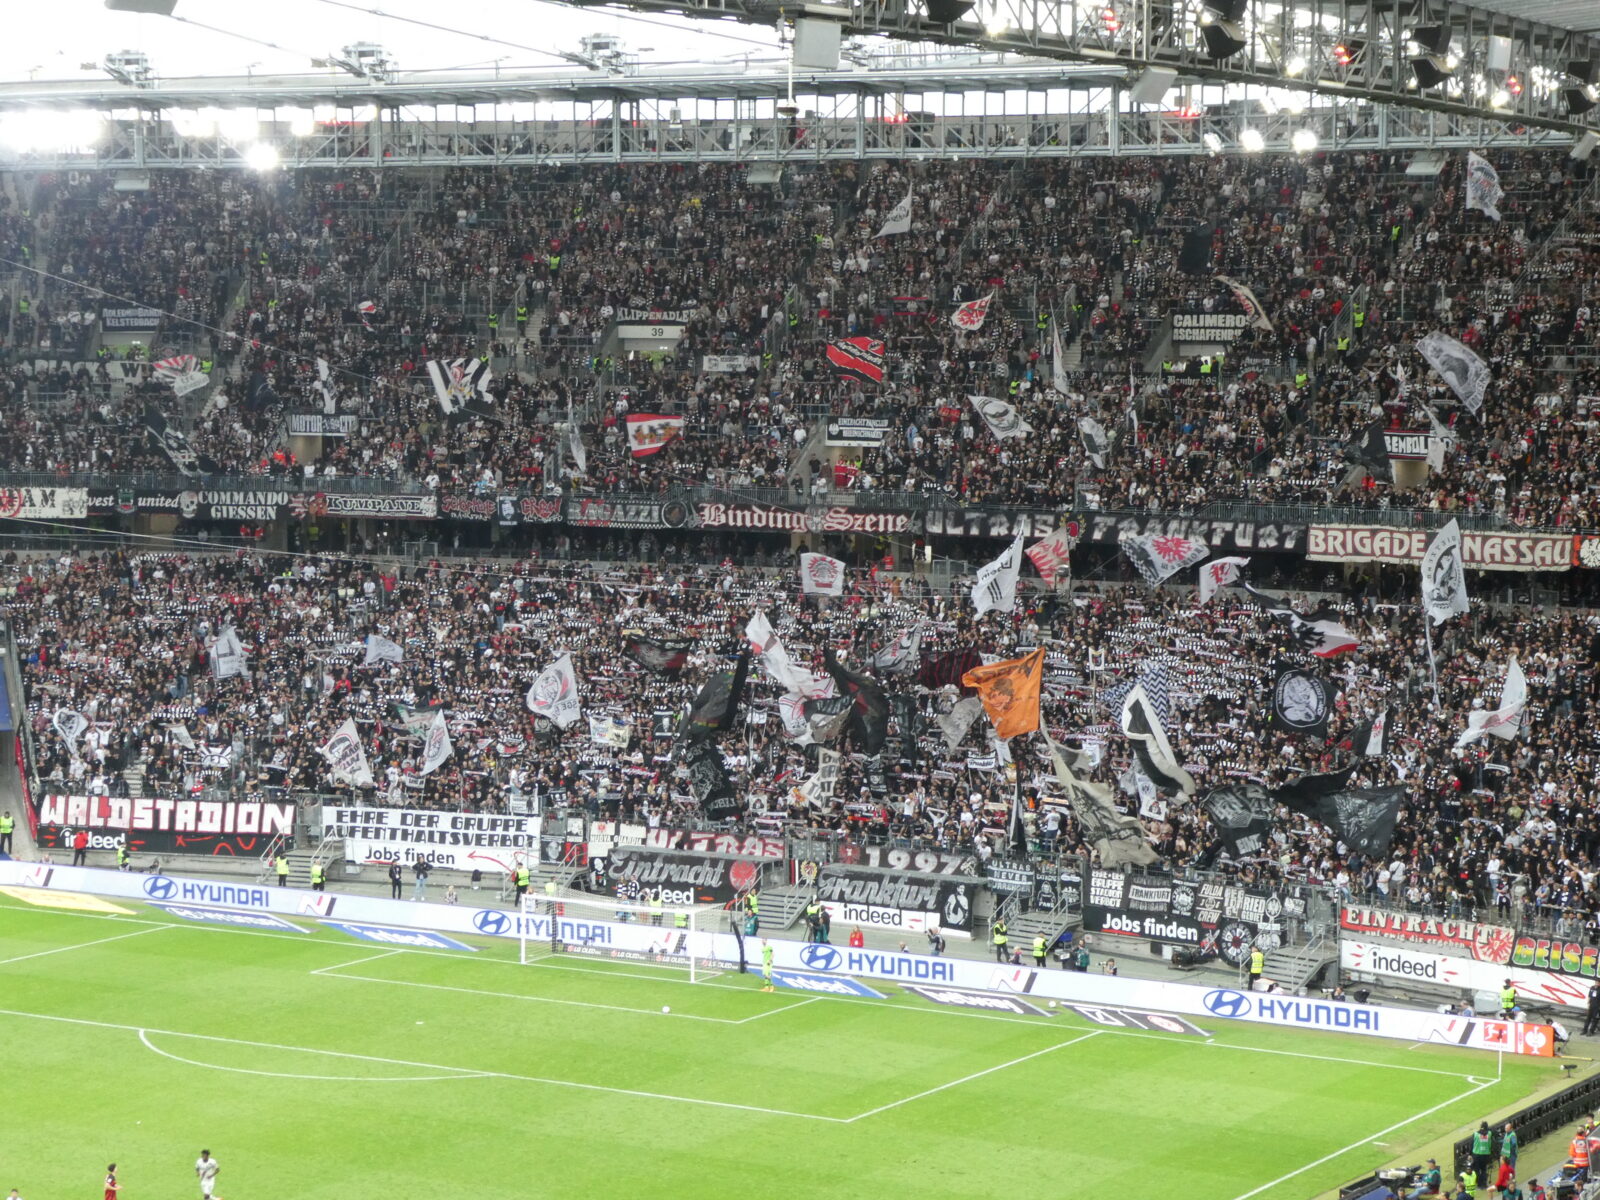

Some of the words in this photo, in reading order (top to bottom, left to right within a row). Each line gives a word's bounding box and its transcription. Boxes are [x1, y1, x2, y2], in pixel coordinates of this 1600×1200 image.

[616, 306, 697, 323] KLIPPENADLER
[651, 328, 664, 337] 39
[1173, 328, 1243, 341] ASCHAFFENBU
[292, 414, 322, 432] MOTOR
[138, 493, 180, 508] united
[198, 491, 288, 505] COMMANDO
[325, 496, 421, 512] KUMPANE
[211, 505, 277, 520] GIESSEN
[701, 503, 808, 533] Binding
[824, 505, 908, 533] Szene
[925, 510, 1056, 537] ULTRAS
[1091, 515, 1307, 550] FRANKFURT
[1309, 527, 1427, 558] BRIGADE
[1463, 533, 1573, 567] NASSAU
[40, 794, 296, 835] WALDSTADION
[336, 810, 389, 825] EHRE
[400, 813, 440, 828] DER
[451, 816, 528, 832] GRUPPE
[324, 825, 537, 849] AUFENTHALTSVERBOT
[590, 834, 611, 843] NUOVA
[613, 834, 642, 845] GUARDIA
[365, 847, 401, 862] Jobs
[405, 848, 455, 865] finden
[865, 846, 964, 875] 1997
[607, 850, 725, 888] Eintracht
[992, 860, 1031, 872] ULTRAS
[993, 870, 1027, 882] NEVER
[1091, 877, 1124, 890] GRUPPE
[182, 882, 269, 907] HYUNDAI
[818, 873, 941, 911] Frankfurt
[1090, 886, 1123, 899] STADION
[1131, 888, 1170, 901] FRANKFURT
[1200, 884, 1224, 897] FULDA
[1090, 895, 1122, 908] VERBOT
[1242, 896, 1265, 914] RIED
[843, 904, 902, 926] indeed
[1197, 911, 1221, 923] CREW
[1241, 911, 1264, 923] GEBIET
[517, 916, 612, 944] HYUNDAI
[1102, 913, 1141, 933] Jobs
[1143, 918, 1198, 941] finden
[1346, 907, 1493, 944] EINTRACHT
[848, 952, 954, 981] HYUNDAI
[1372, 952, 1436, 979] indeed
[1512, 937, 1600, 978] GEISE
[1258, 998, 1379, 1031] HYUNDAI
